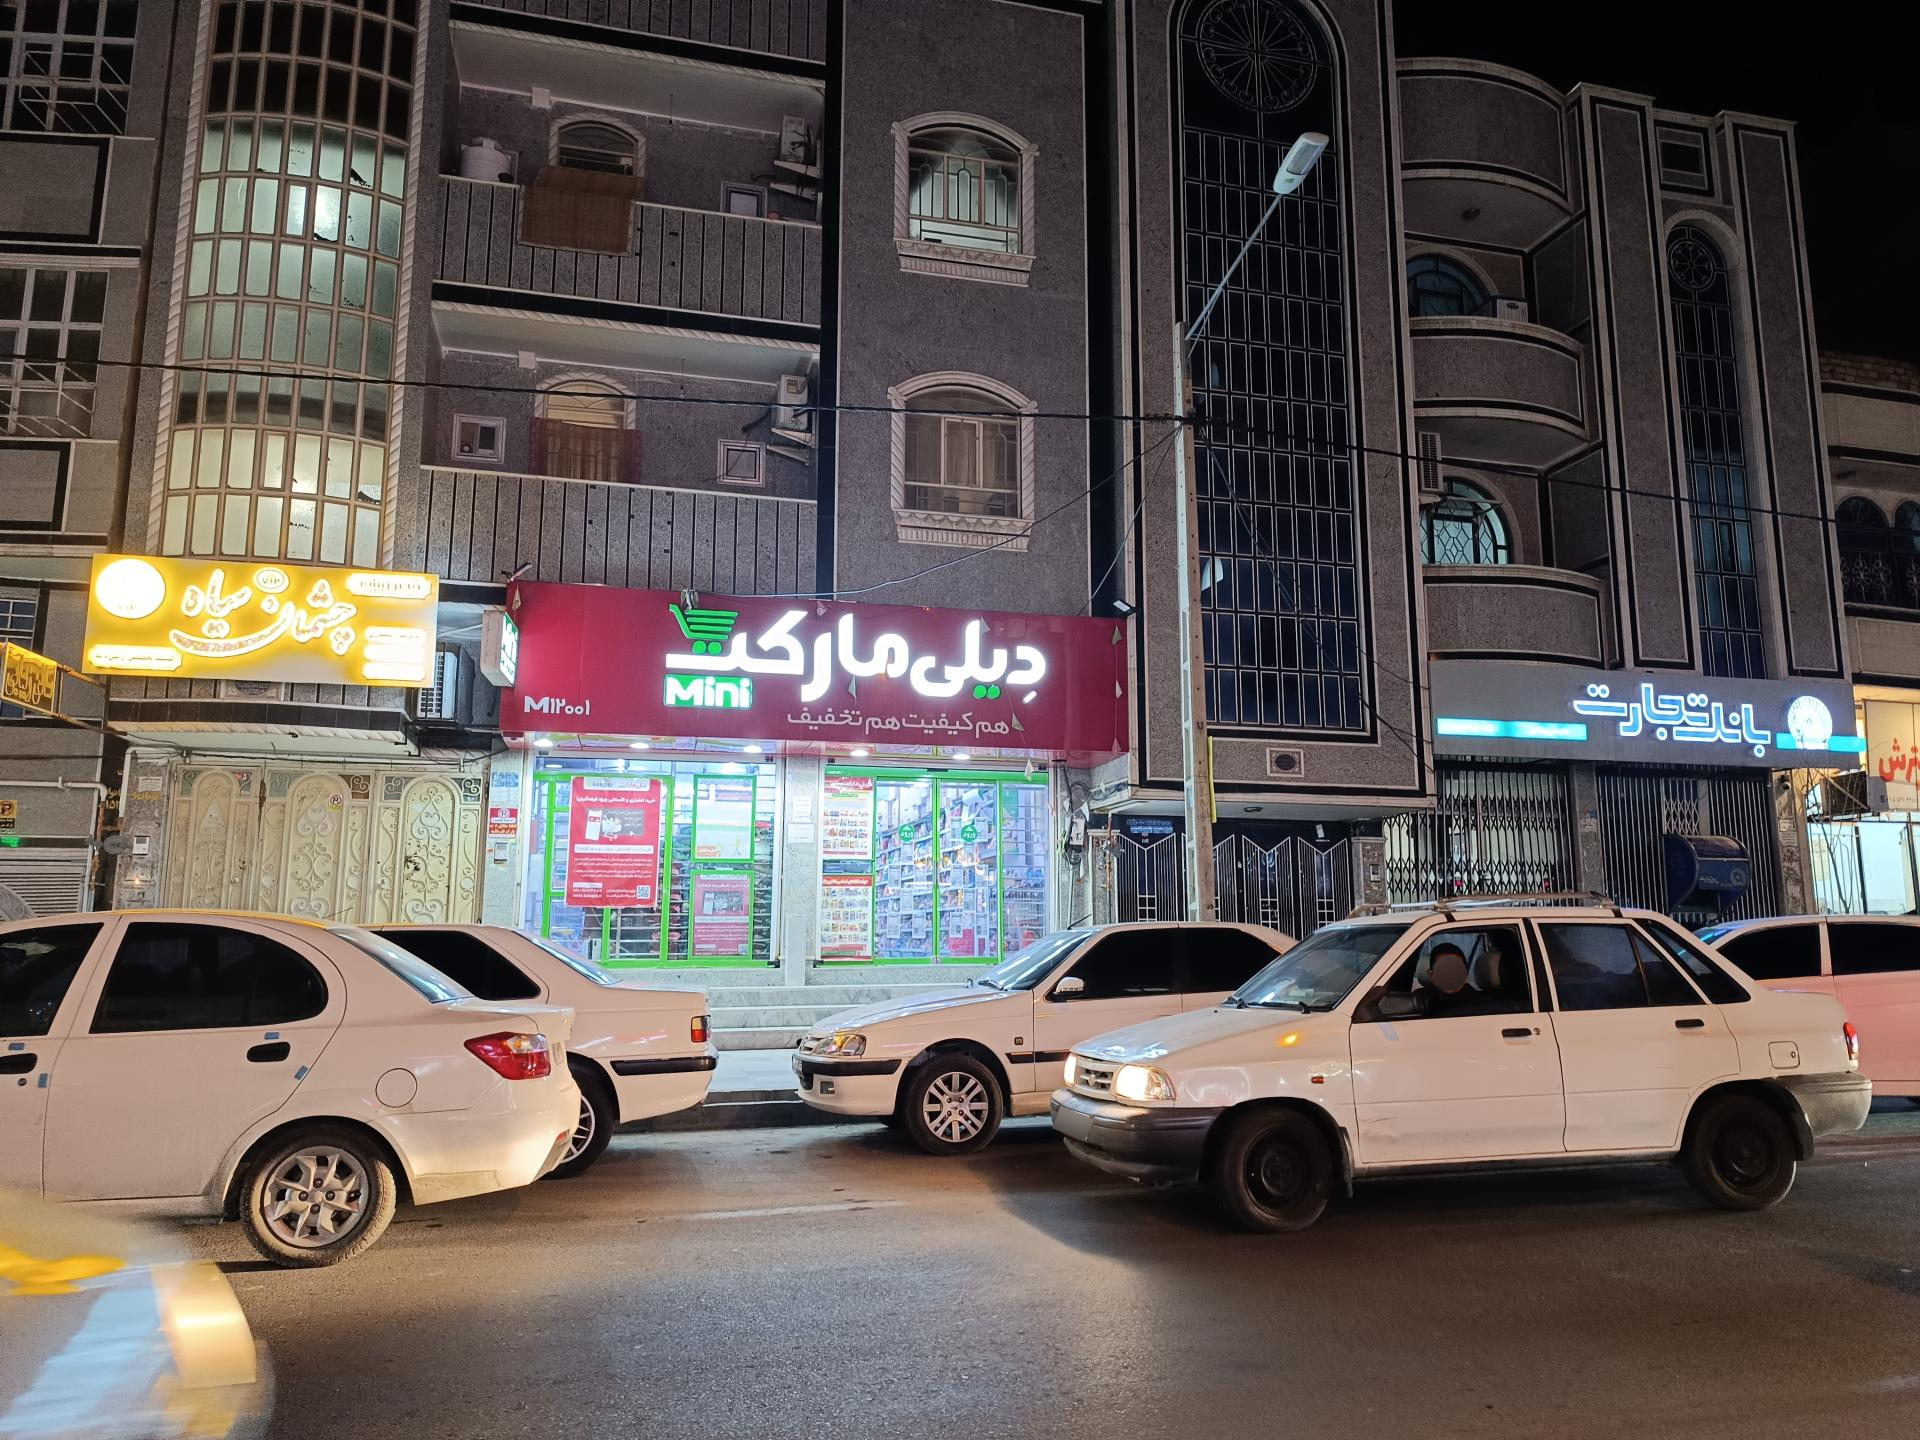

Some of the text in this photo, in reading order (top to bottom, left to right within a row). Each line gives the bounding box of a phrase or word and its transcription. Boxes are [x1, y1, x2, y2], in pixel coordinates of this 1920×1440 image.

[169, 578, 359, 657] چشمان
[664, 609, 1048, 704] دیلی مارکت
[665, 676, 751, 708] Mini
[786, 707, 1010, 738] هم کیفیت هم تخفیف
[1572, 682, 1772, 758] بانک تجارت
